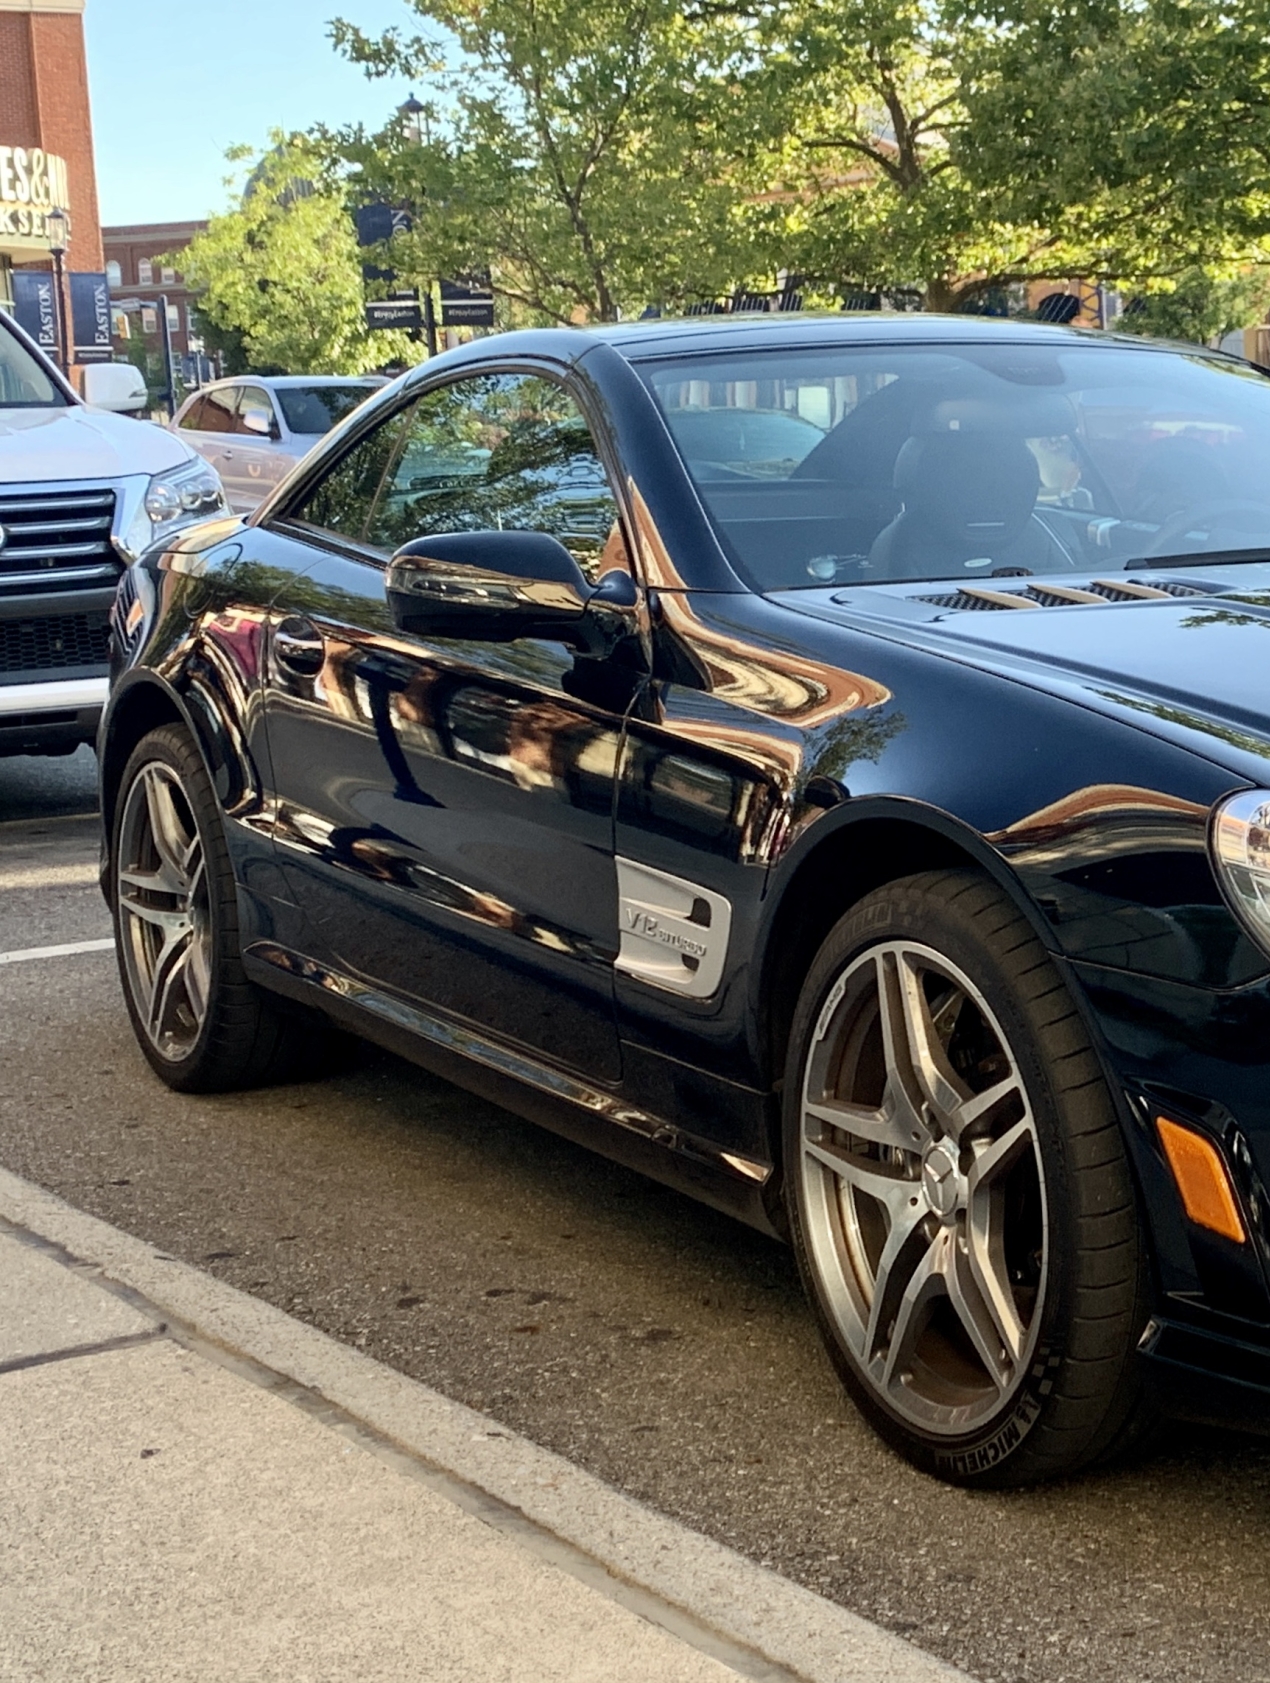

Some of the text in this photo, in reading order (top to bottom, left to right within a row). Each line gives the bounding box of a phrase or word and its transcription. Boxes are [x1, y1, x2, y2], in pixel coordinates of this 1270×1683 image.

[38, 282, 55, 344] EASTON
[94, 282, 110, 344] EASTON
[625, 907, 707, 958] V12 BITURBO
